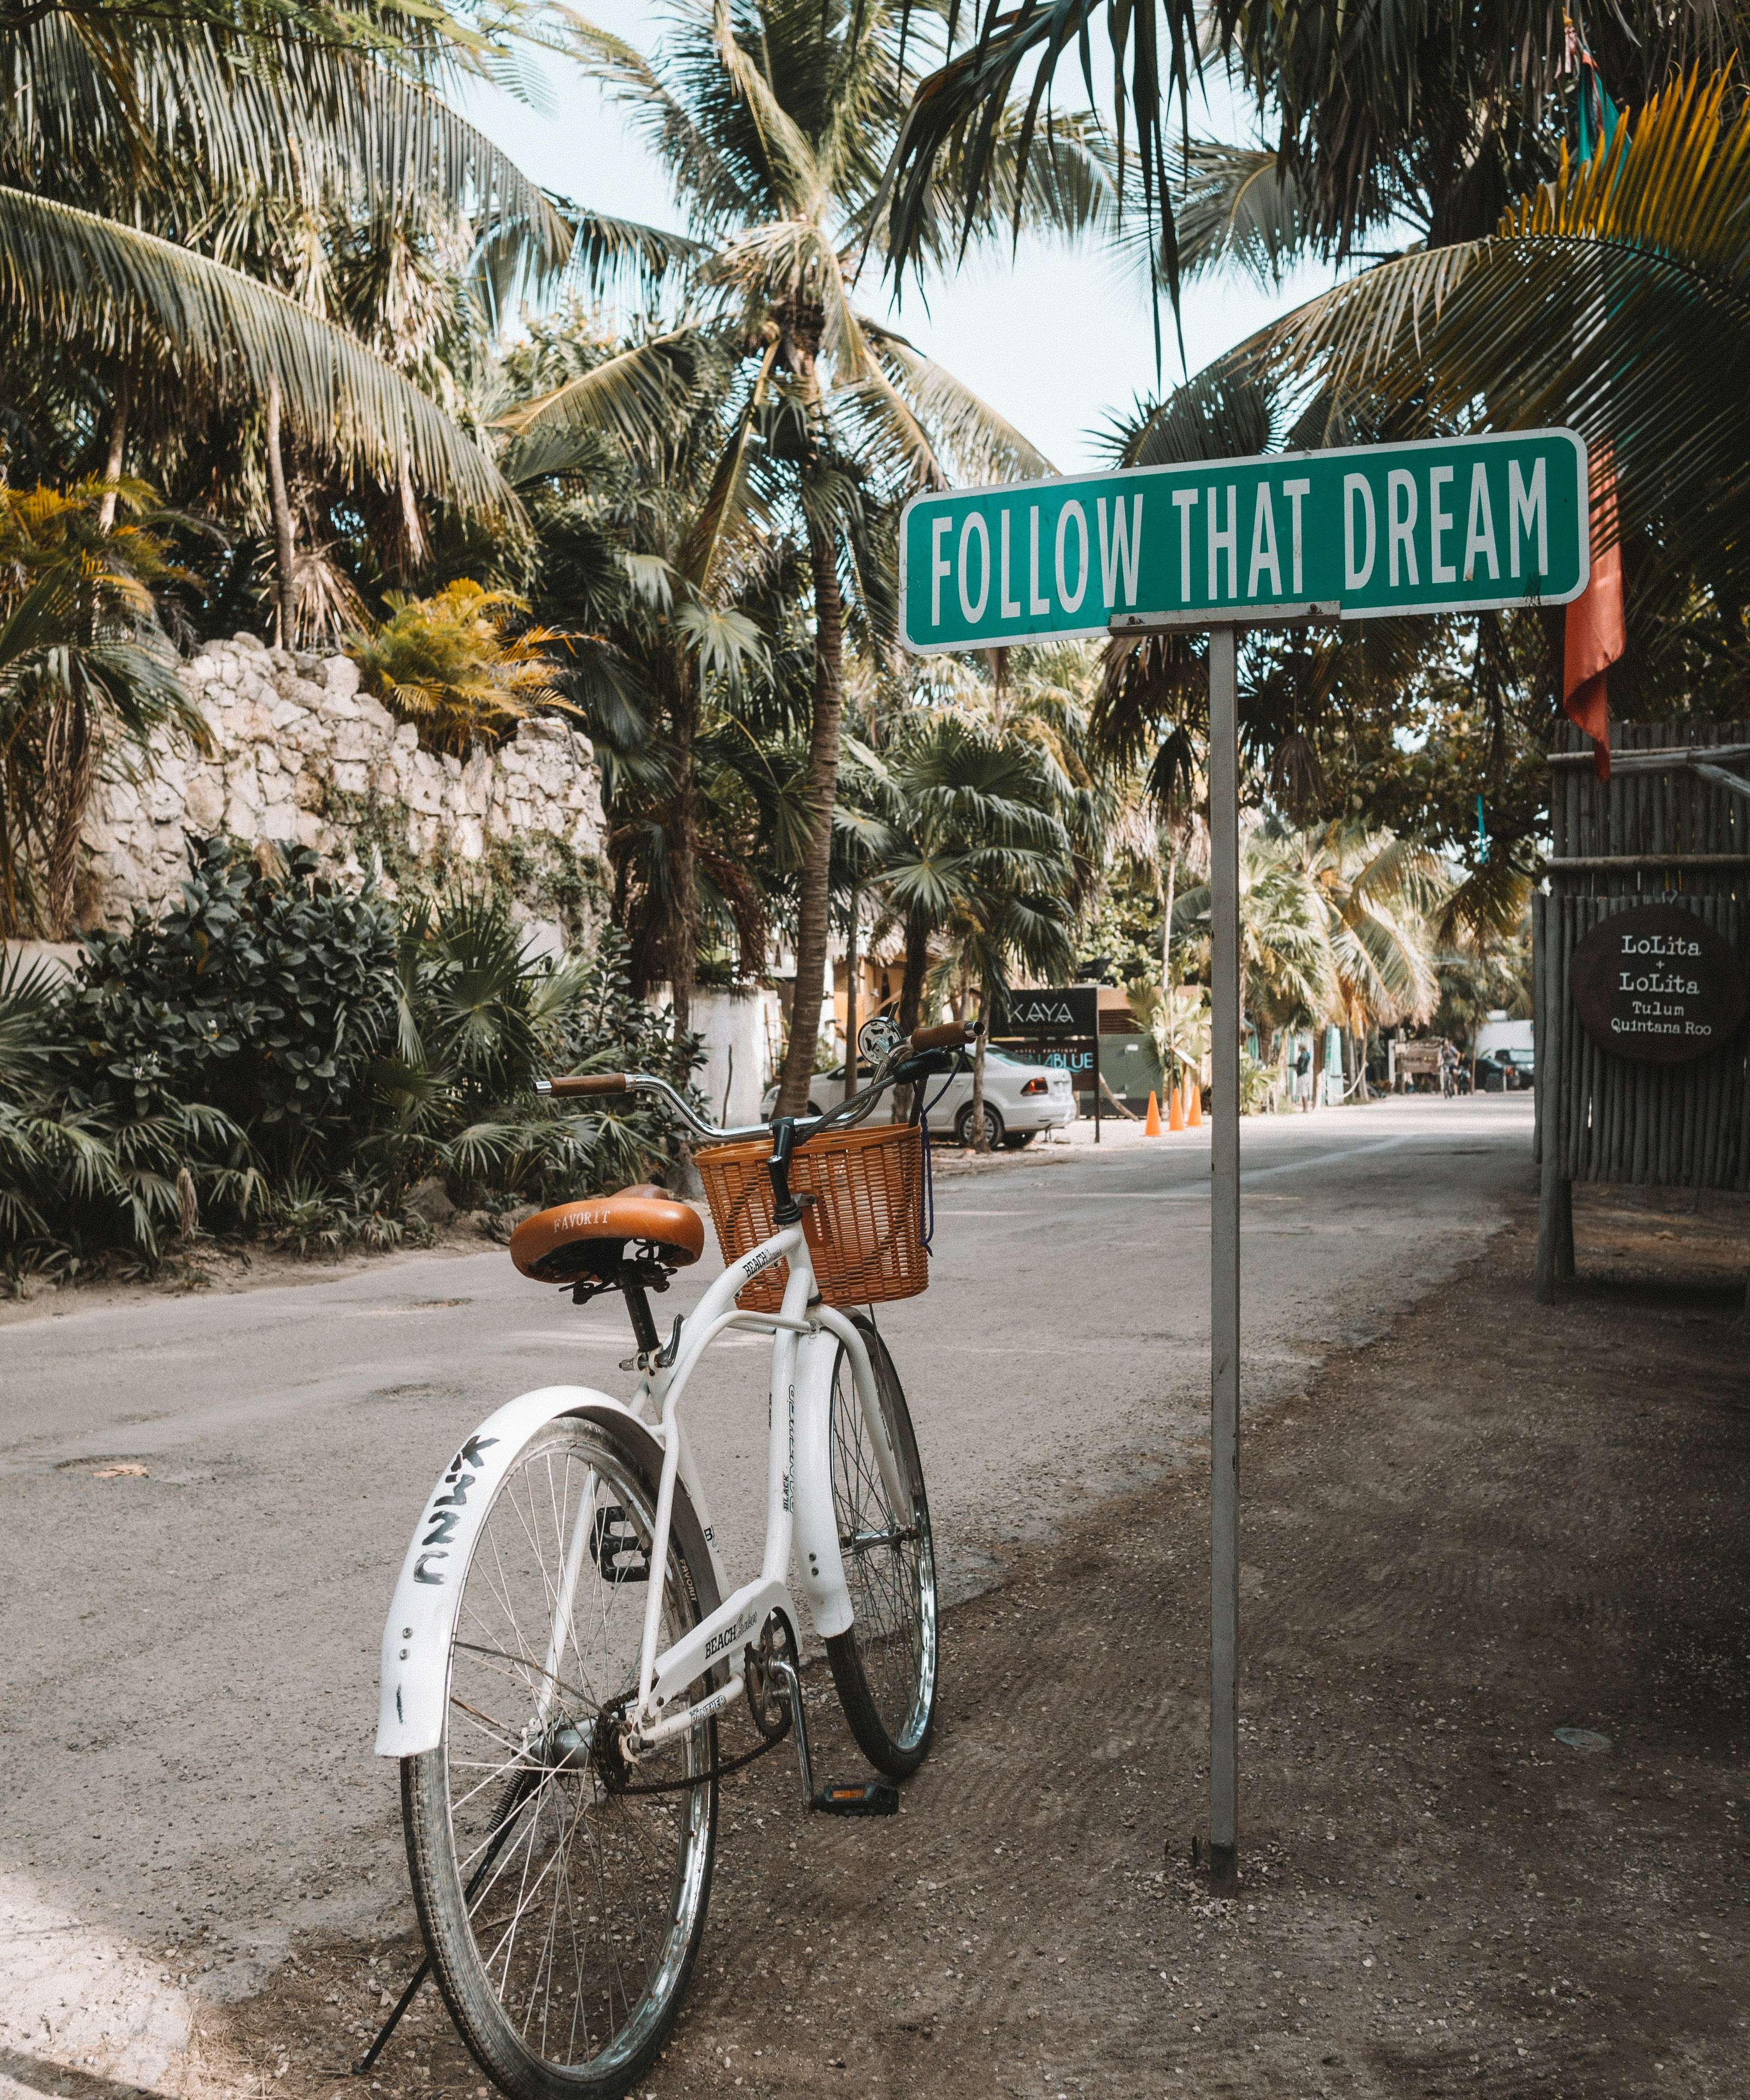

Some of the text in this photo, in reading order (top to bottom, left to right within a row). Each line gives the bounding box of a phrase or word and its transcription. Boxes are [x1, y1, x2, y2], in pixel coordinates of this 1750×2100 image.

[931, 457, 1548, 627] FOLLOW THAT DREAM
[1621, 935, 1701, 956] LoLita
[1619, 972, 1700, 994] LoLita
[1007, 1002, 1075, 1023] KAYA
[1632, 1001, 1684, 1016] Tulum
[1611, 1017, 1712, 1035] Quintana Roo
[554, 1209, 611, 1234] FAVORIT
[742, 1251, 766, 1279] BEACH
[679, 1558, 697, 1602] FAVORIT
[705, 1624, 737, 1660] BEACH
[690, 1694, 726, 1724] PANTHER
